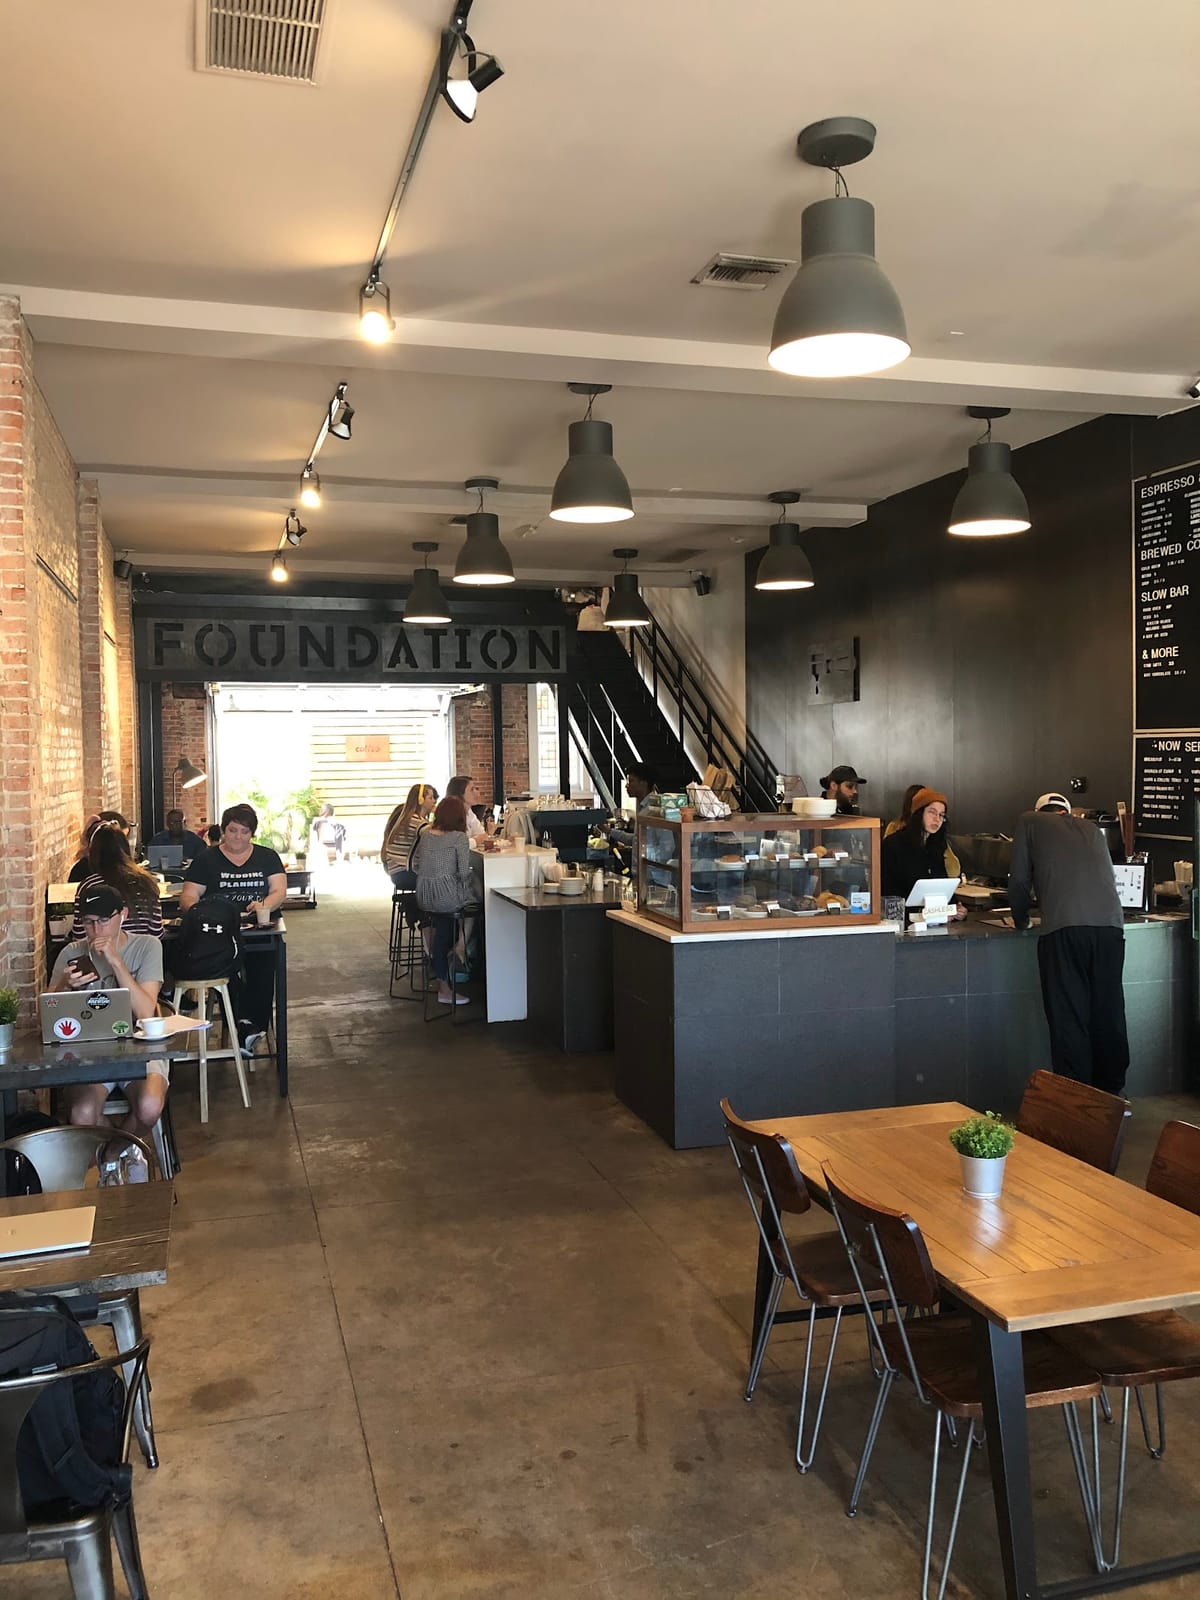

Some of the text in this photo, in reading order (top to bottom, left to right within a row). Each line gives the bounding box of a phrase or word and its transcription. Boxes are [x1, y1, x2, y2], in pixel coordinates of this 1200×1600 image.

[1141, 475, 1195, 499] ESPRESSO
[1141, 543, 1182, 561] BREWED
[1141, 585, 1189, 602] SLOW BAR
[153, 622, 561, 670] FOUNDATION
[1142, 646, 1179, 660] & MORE
[1158, 740, 1181, 751] NOW
[220, 871, 264, 879] WEDDING
